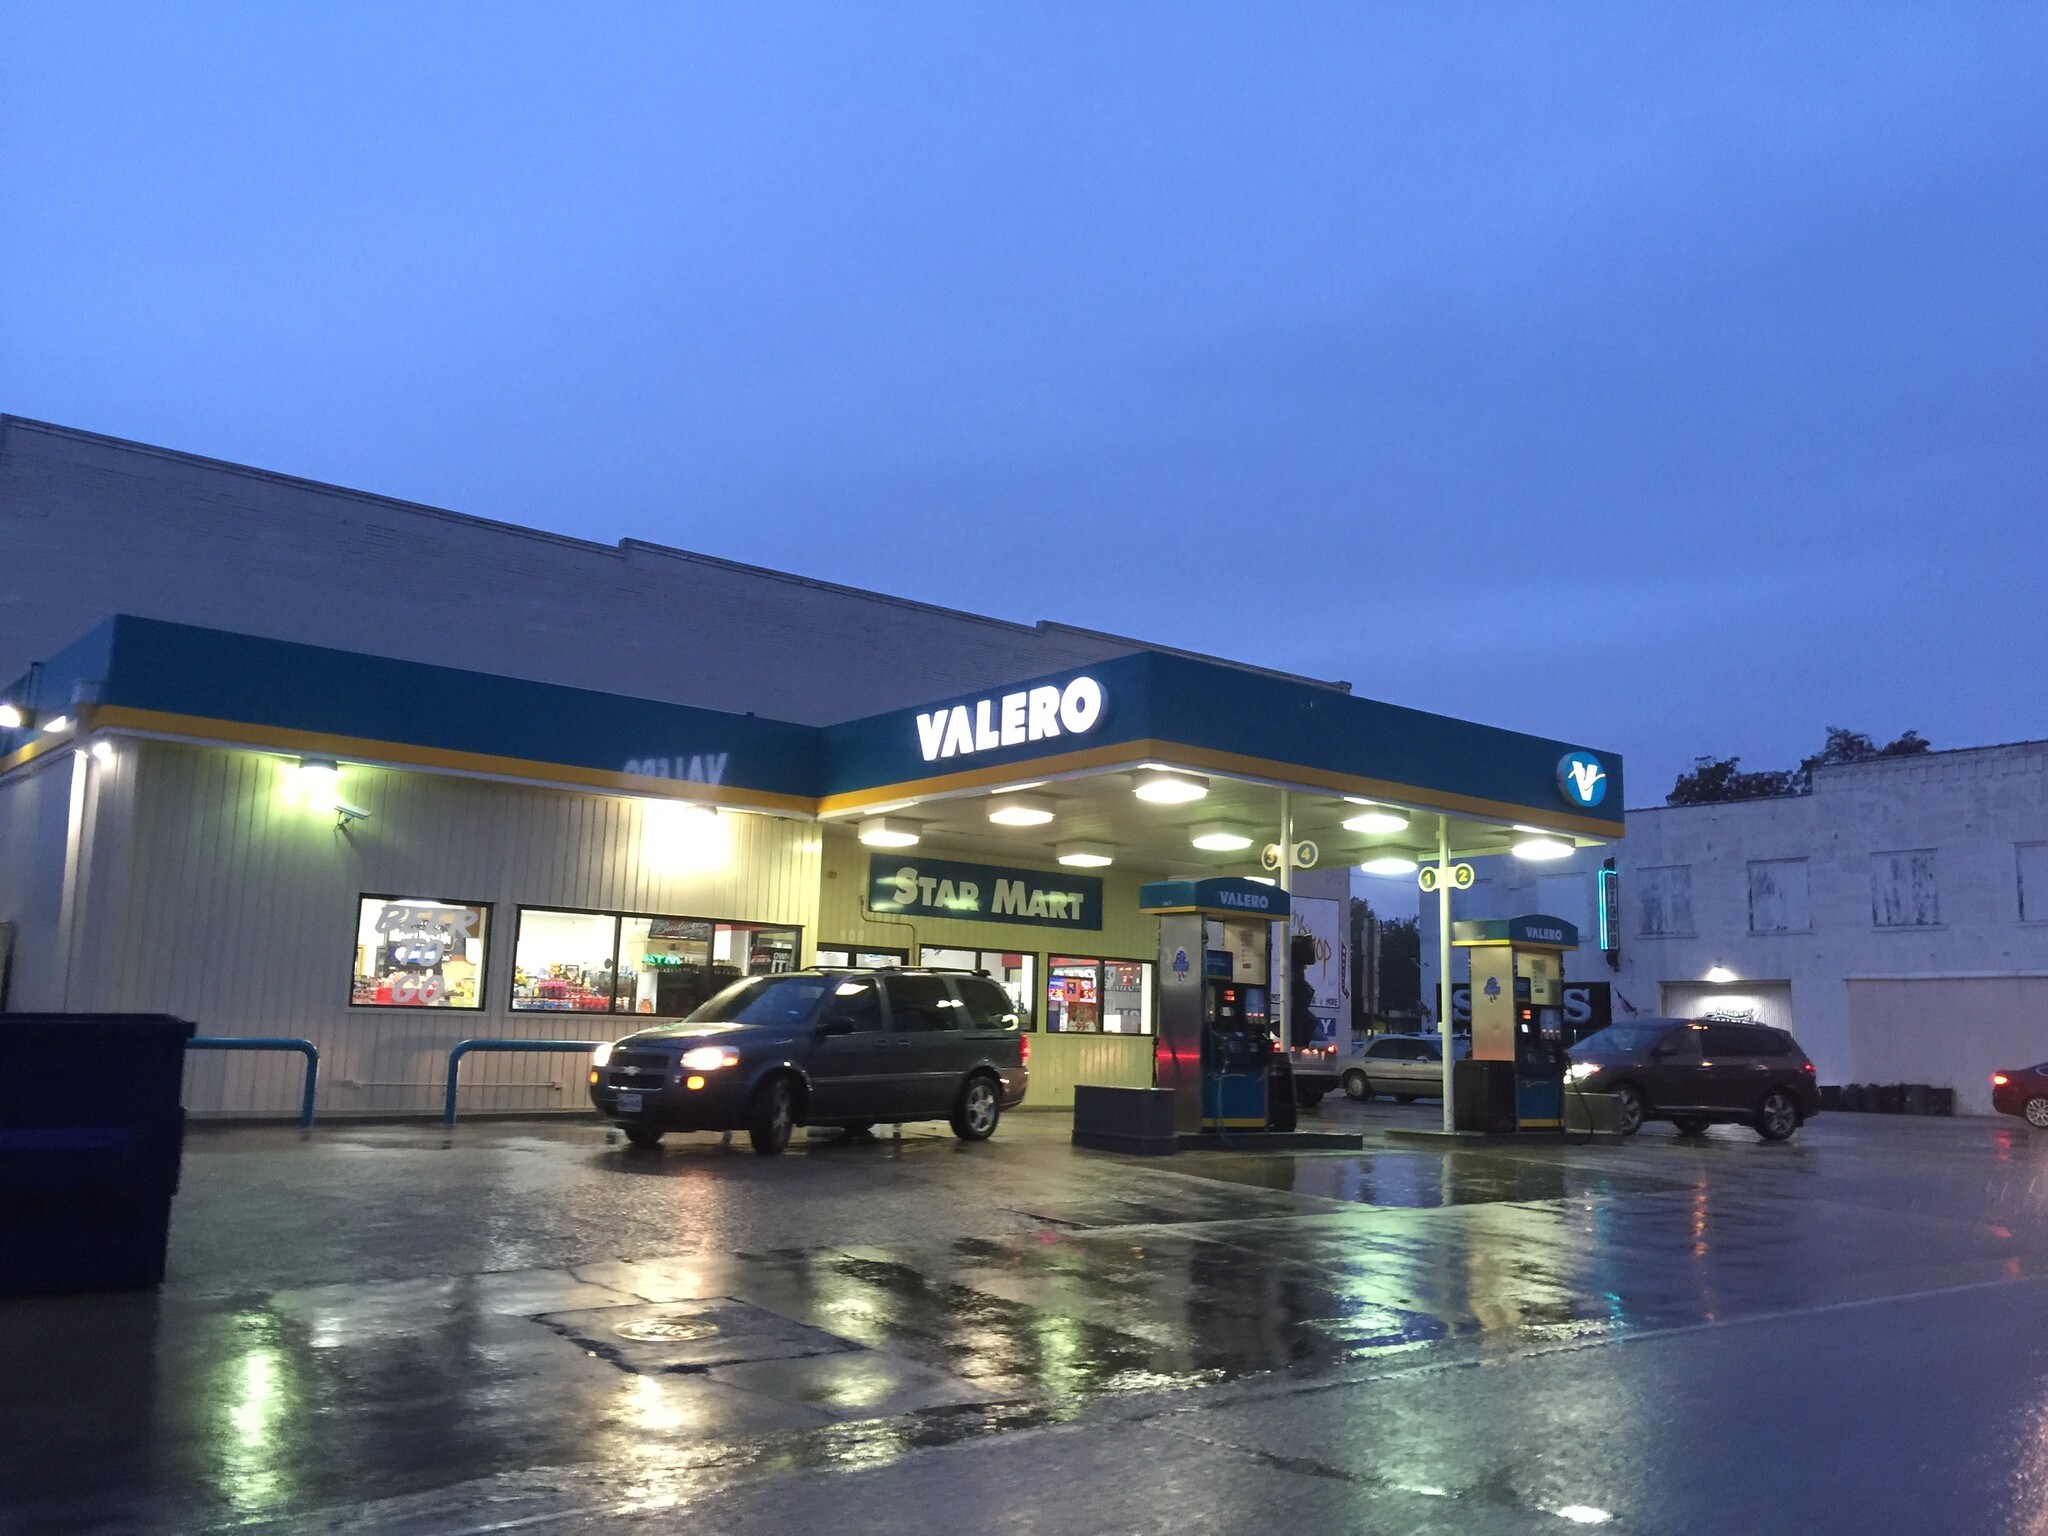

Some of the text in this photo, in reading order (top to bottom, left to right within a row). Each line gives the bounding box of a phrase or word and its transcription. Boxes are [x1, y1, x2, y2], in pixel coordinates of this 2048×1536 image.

[916, 676, 1101, 761] VALERO
[1266, 851, 1276, 864] 3
[1301, 848, 1311, 860] 4
[1423, 873, 1432, 885] 1
[1458, 869, 1468, 882] 2
[1219, 891, 1268, 909] VALERO
[375, 904, 479, 938] BEER
[1525, 927, 1562, 941] VALERO
[400, 939, 444, 967] TO
[643, 954, 683, 966] ATM
[392, 974, 445, 1003] GO
